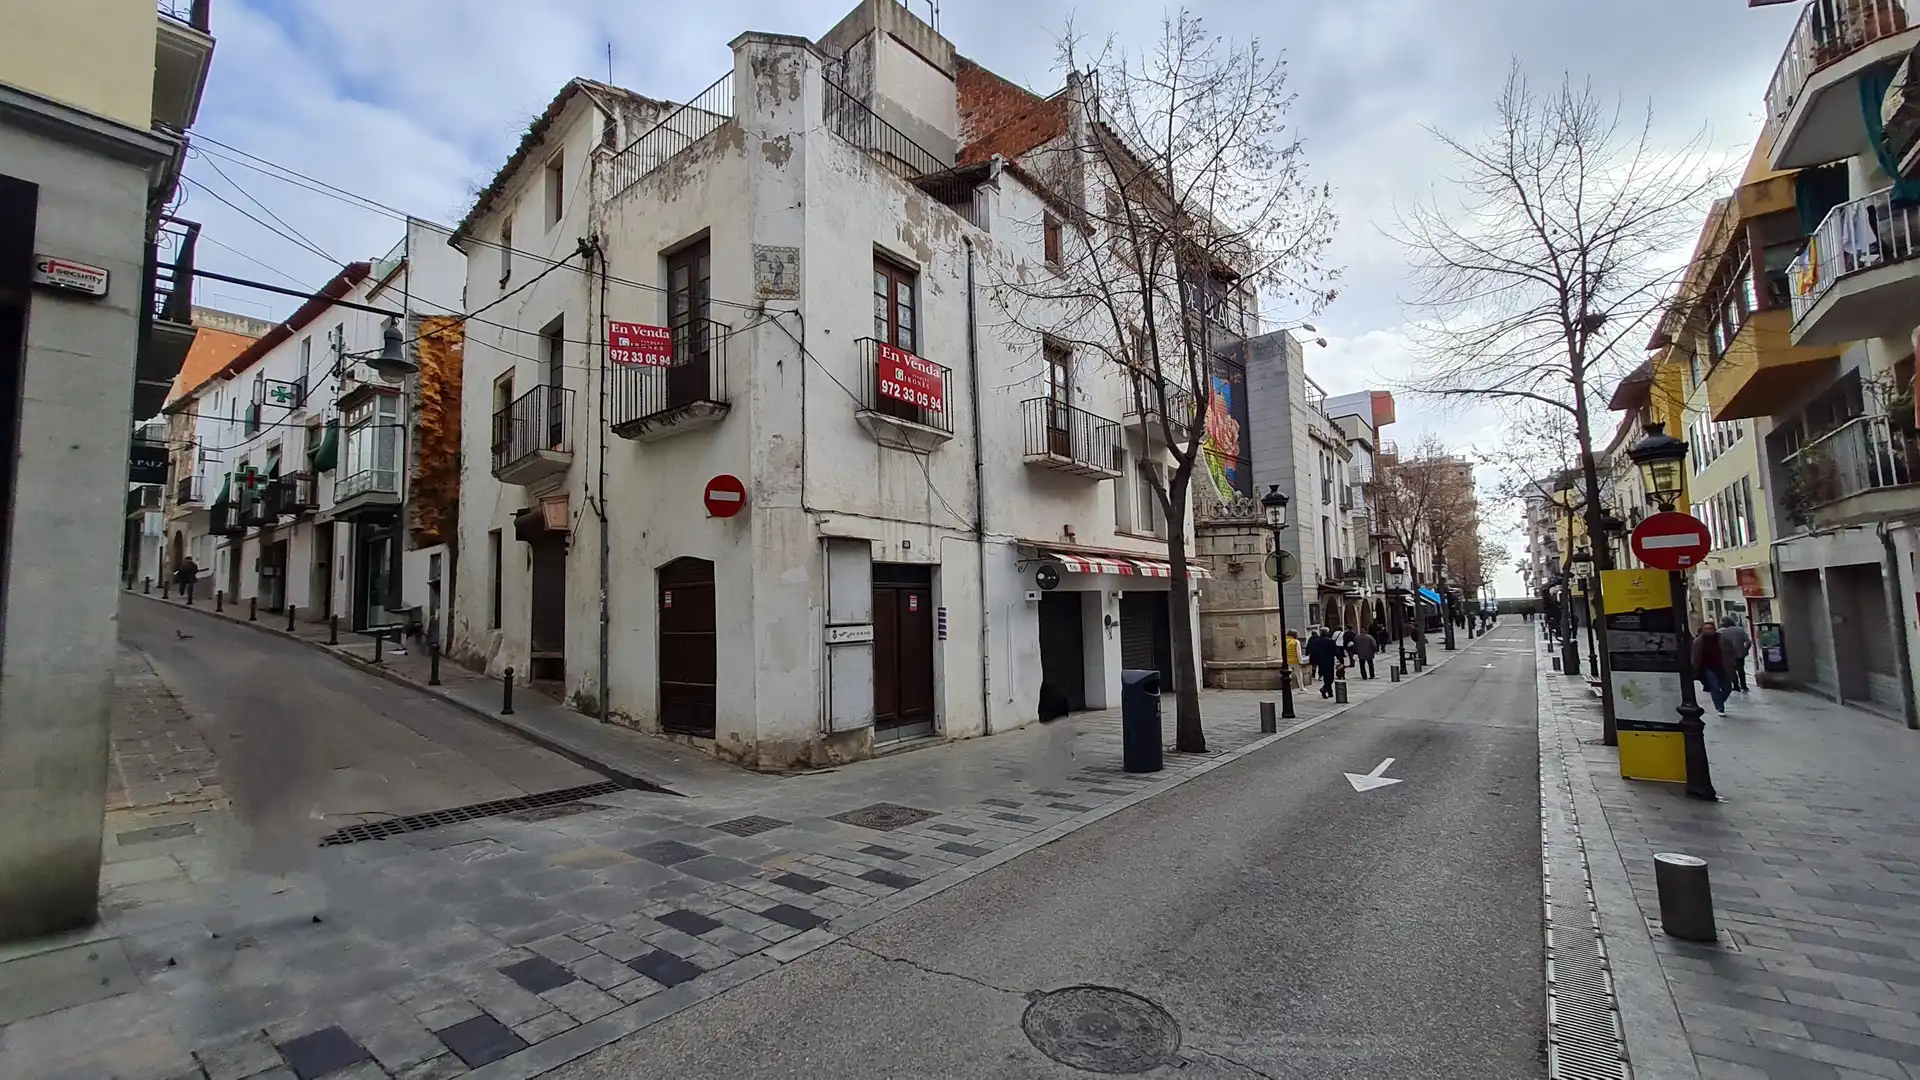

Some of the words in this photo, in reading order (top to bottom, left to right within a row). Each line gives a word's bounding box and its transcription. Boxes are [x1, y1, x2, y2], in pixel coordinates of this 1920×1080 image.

[55, 267, 104, 284] security
[611, 323, 628, 334] En
[632, 325, 670, 338] Venda
[611, 349, 629, 361] 972
[631, 351, 643, 363] 33
[645, 353, 657, 365] 05
[659, 355, 671, 366] 94
[881, 346, 900, 363] En
[903, 354, 941, 378] Venda
[881, 379, 900, 398] 972
[902, 386, 915, 402] 33
[917, 391, 929, 407] 05
[930, 396, 942, 412] 94
